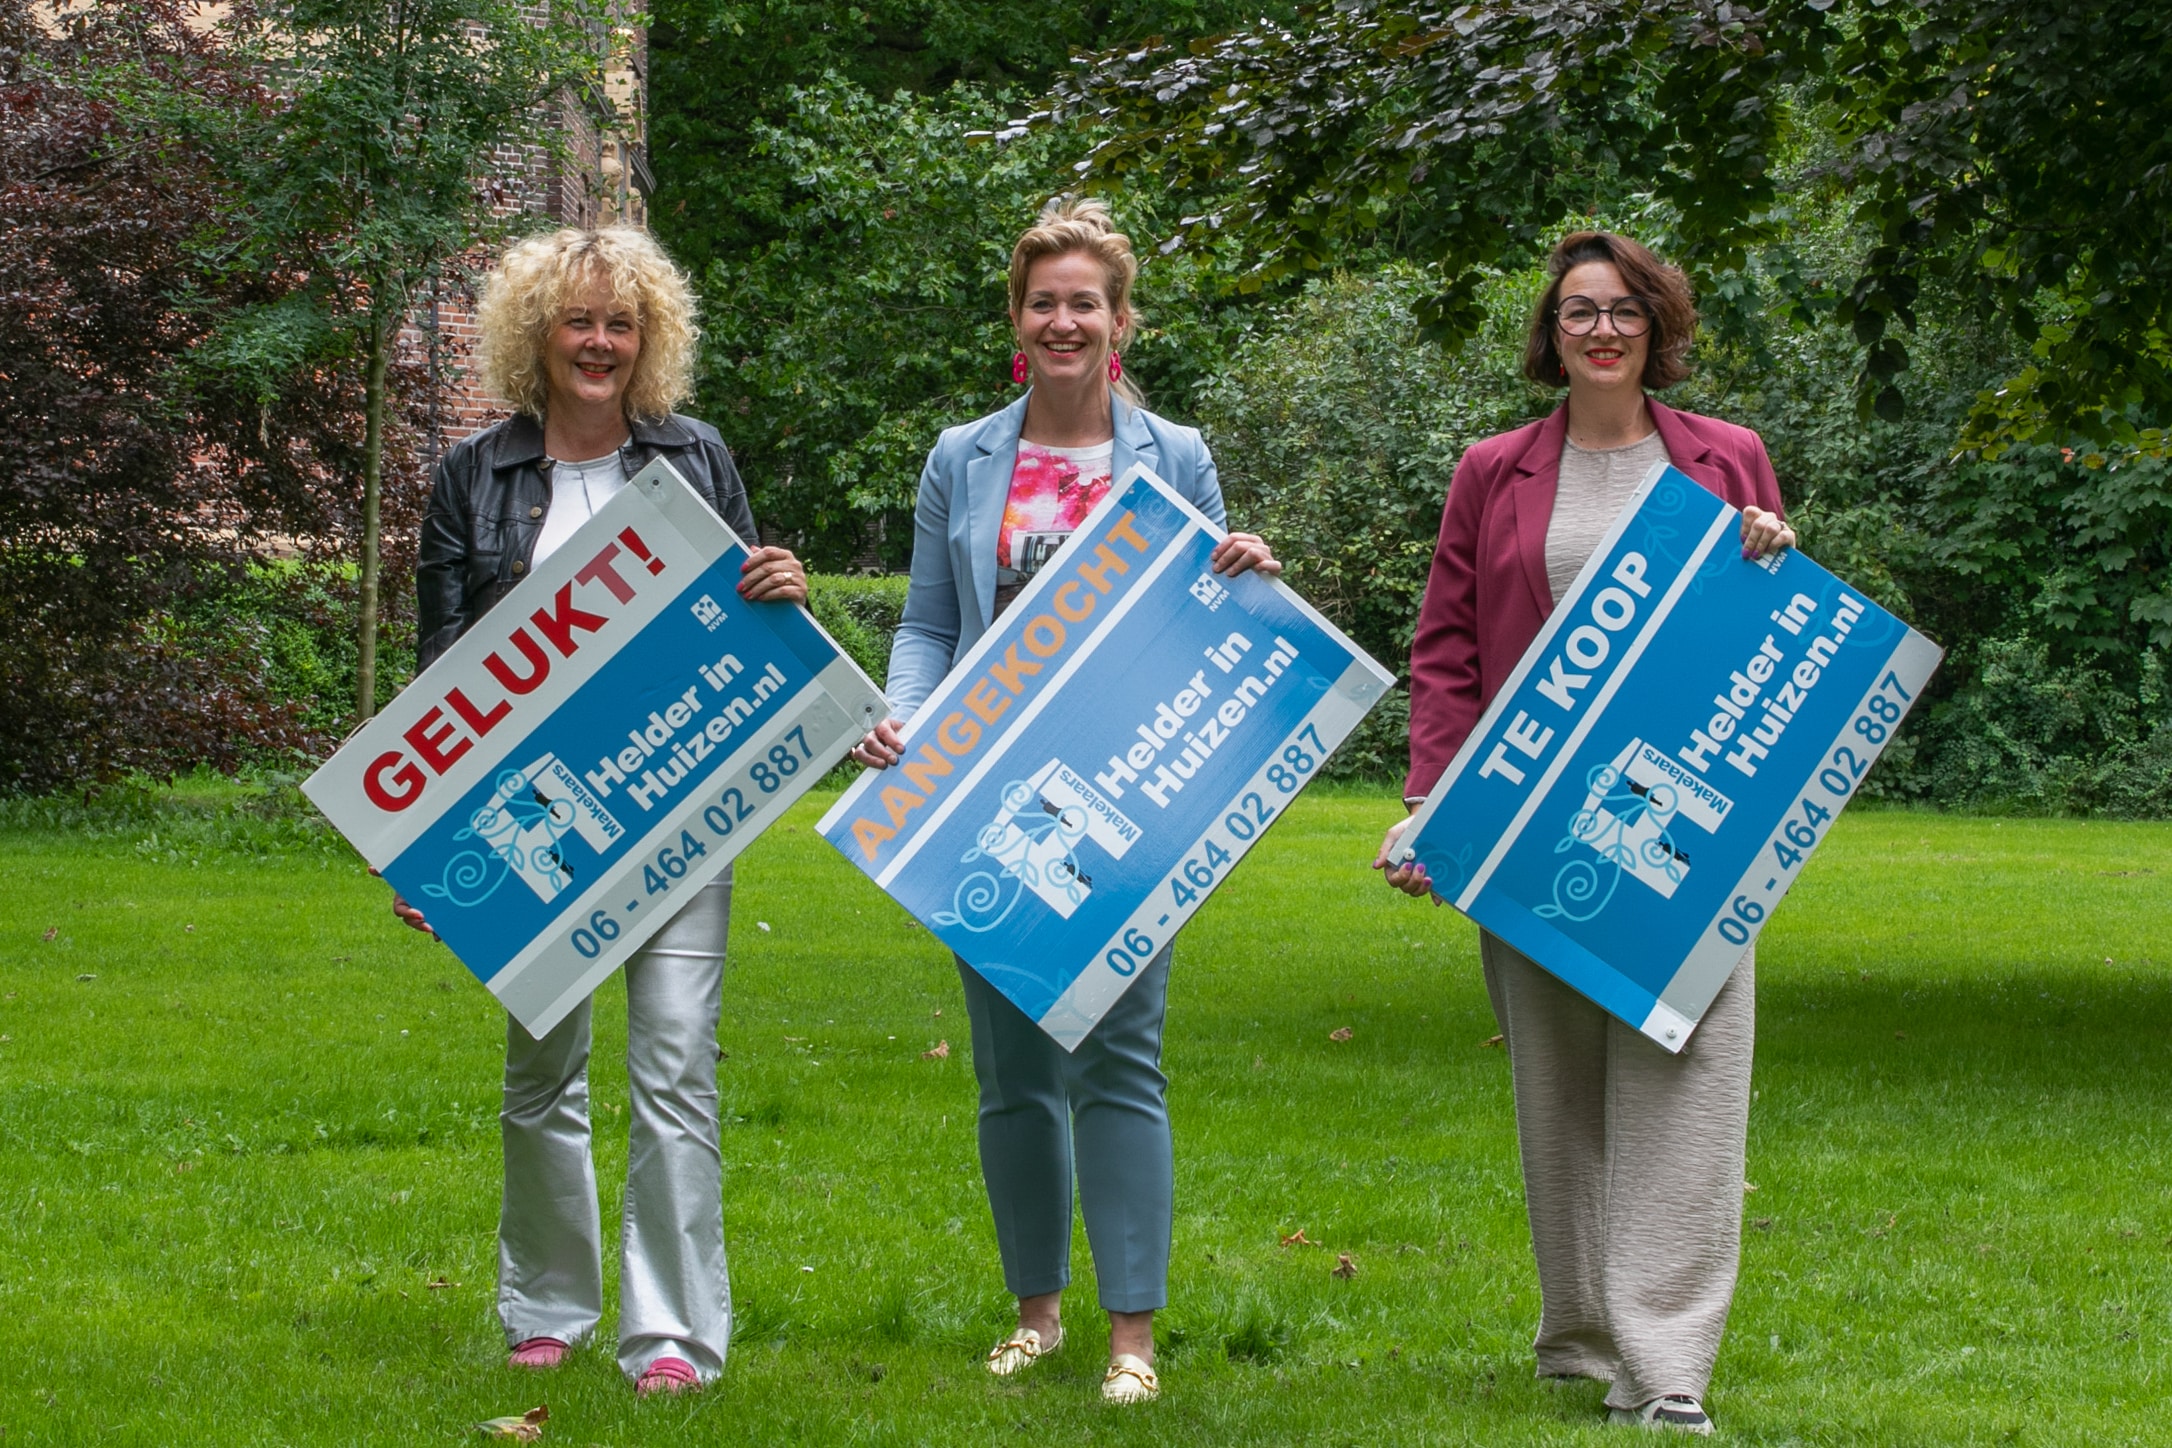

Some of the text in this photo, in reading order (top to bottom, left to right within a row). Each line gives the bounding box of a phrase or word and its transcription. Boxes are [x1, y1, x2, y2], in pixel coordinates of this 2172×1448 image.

[706, 612, 728, 633] NVM
[1208, 590, 1230, 613] NVM
[1768, 552, 1788, 575] NVM
[362, 526, 666, 812] GELUKT!
[585, 653, 744, 797] Helder in
[627, 663, 787, 811] Huizen.nl
[851, 510, 1150, 862] AANGEKOCHT
[1095, 632, 1252, 799] Helder in
[1140, 636, 1299, 809] Huizen.nl
[1479, 551, 1654, 786] TE KOOP
[1678, 594, 1817, 774] Helder in
[1725, 593, 1866, 778] Huizen.nl
[552, 763, 621, 839] Makelaars
[571, 910, 621, 958] 06
[643, 829, 706, 895] 464
[703, 787, 754, 836] 02
[750, 725, 814, 793] 887
[1058, 770, 1138, 841] Makelaars
[1106, 928, 1154, 977] 06
[1171, 843, 1230, 906] 464
[1226, 792, 1276, 841] 02
[1267, 723, 1328, 793] 887
[1641, 747, 1729, 814] Makelaars
[1718, 894, 1765, 945] 06
[1773, 797, 1831, 872] 464
[1818, 745, 1868, 796] 02
[1854, 671, 1912, 742] 887
